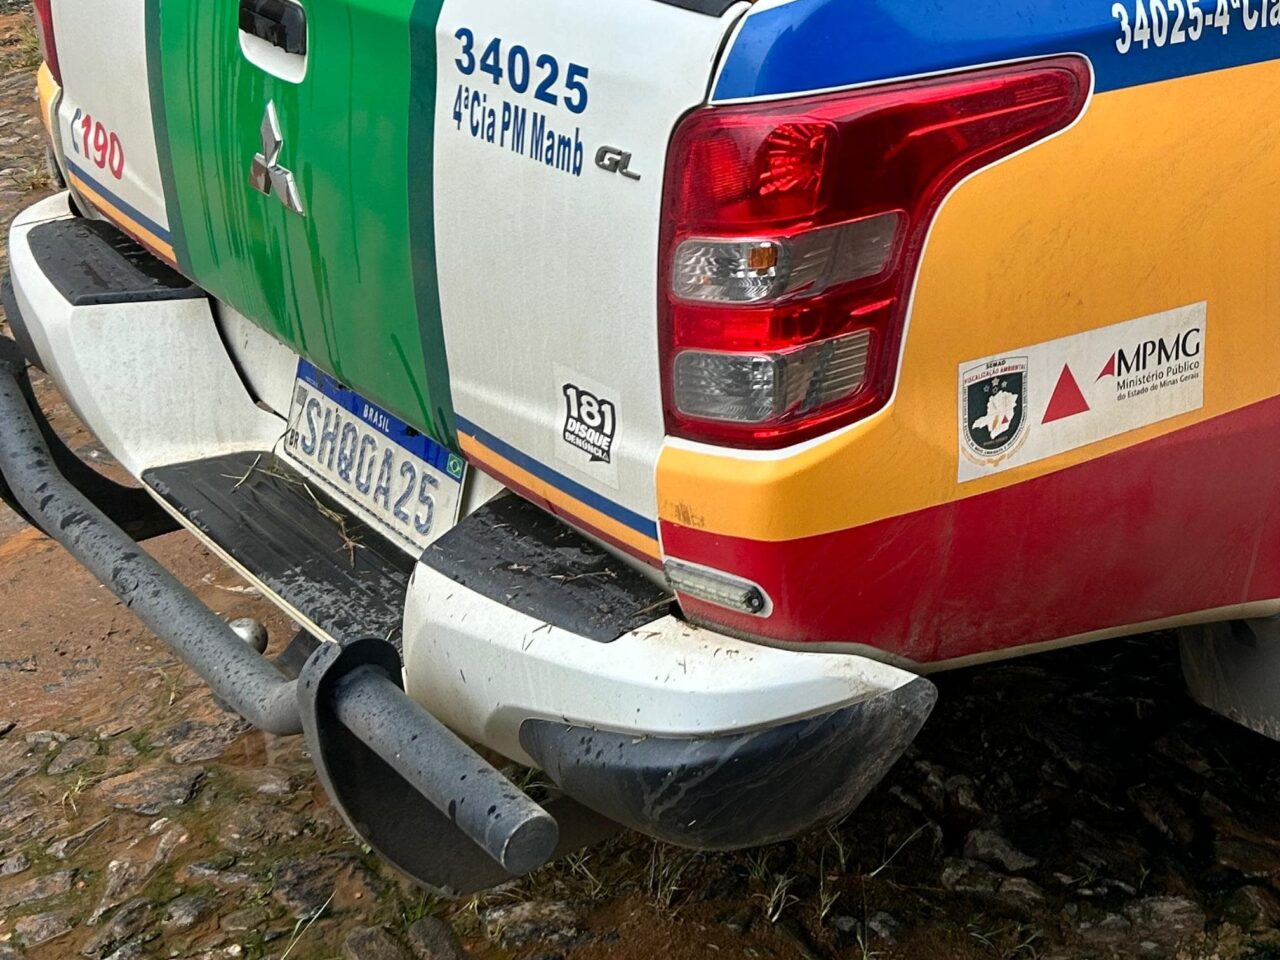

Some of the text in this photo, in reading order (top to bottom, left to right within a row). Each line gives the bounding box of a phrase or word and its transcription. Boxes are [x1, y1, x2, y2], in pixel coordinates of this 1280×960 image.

[454, 27, 589, 114] 34025
[80, 113, 126, 182] 190
[499, 101, 528, 156] PM
[530, 111, 584, 177] Mamb
[594, 145, 641, 181] GL
[1116, 327, 1201, 378] MPMG
[1116, 360, 1200, 392] Ministério Público
[1117, 372, 1199, 401] do Estado de Minas Gerais
[362, 404, 390, 434] BRASIL
[565, 385, 614, 437] 181
[289, 428, 300, 450] BR
[566, 417, 612, 451] DISQUE
